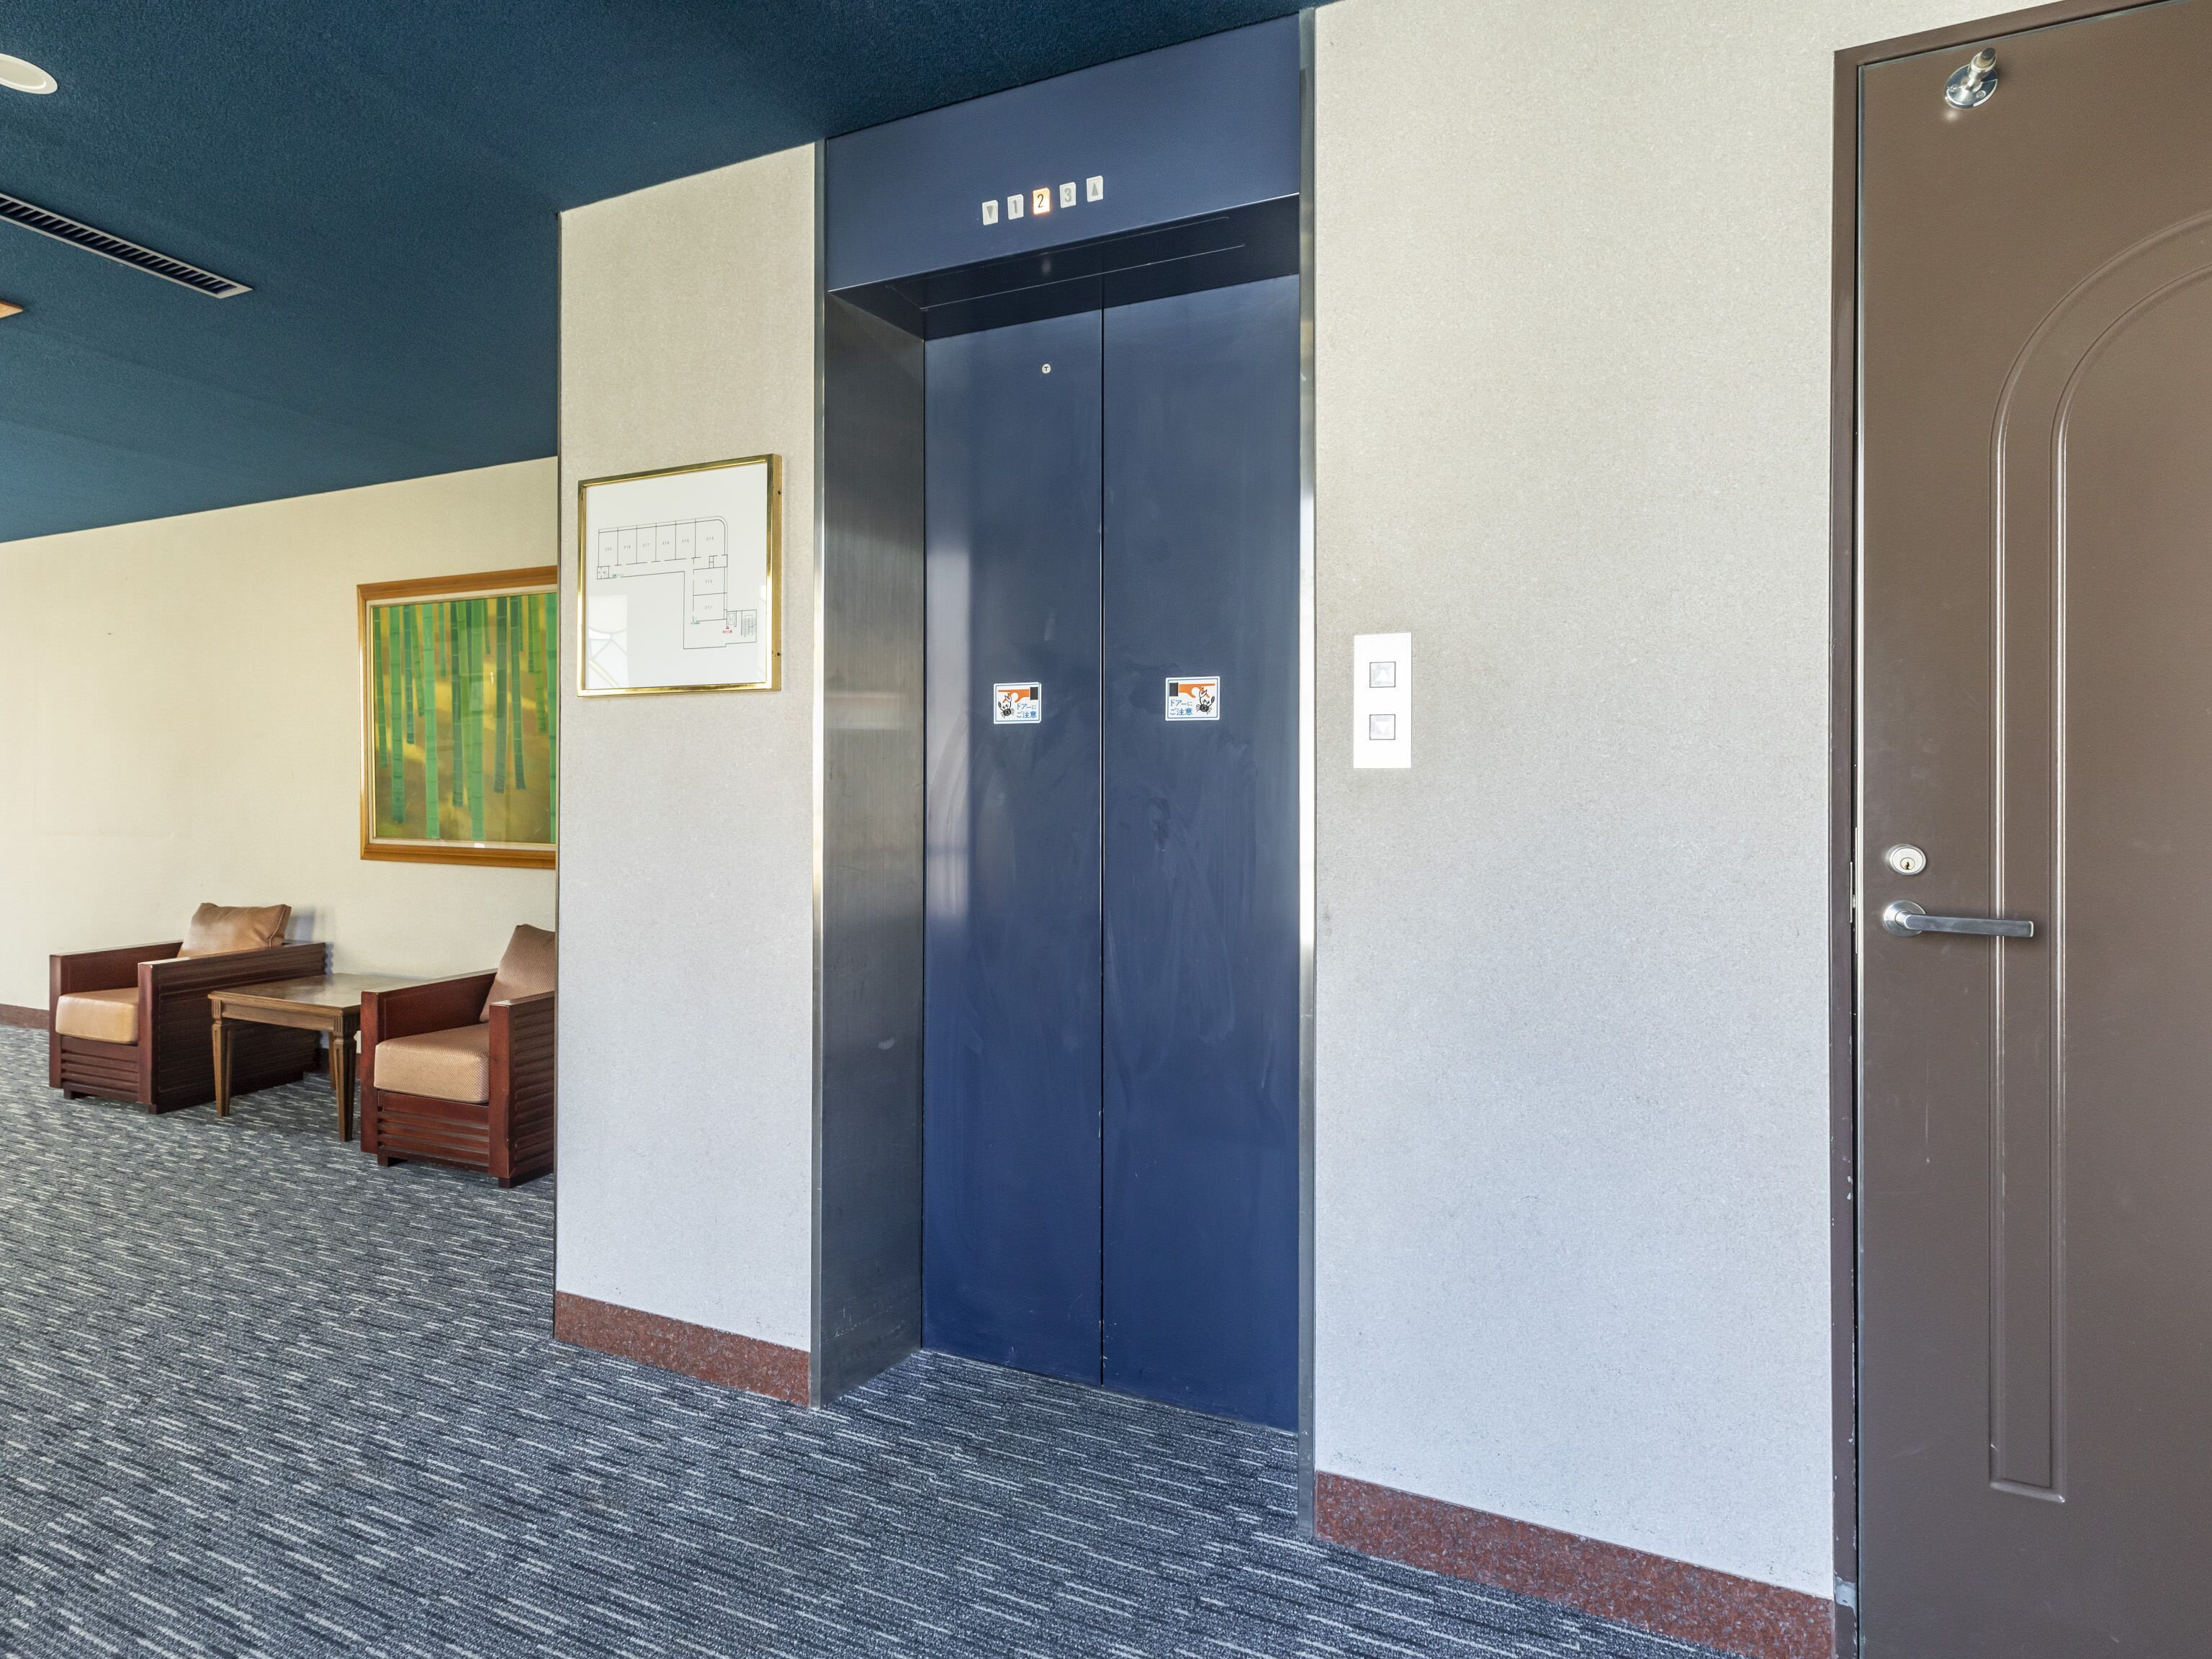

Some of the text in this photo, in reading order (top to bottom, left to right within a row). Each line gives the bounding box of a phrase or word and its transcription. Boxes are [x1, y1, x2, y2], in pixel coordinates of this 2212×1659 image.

[1012, 187, 1072, 213] 1 2 3
[1170, 707, 1193, 716] ご注意
